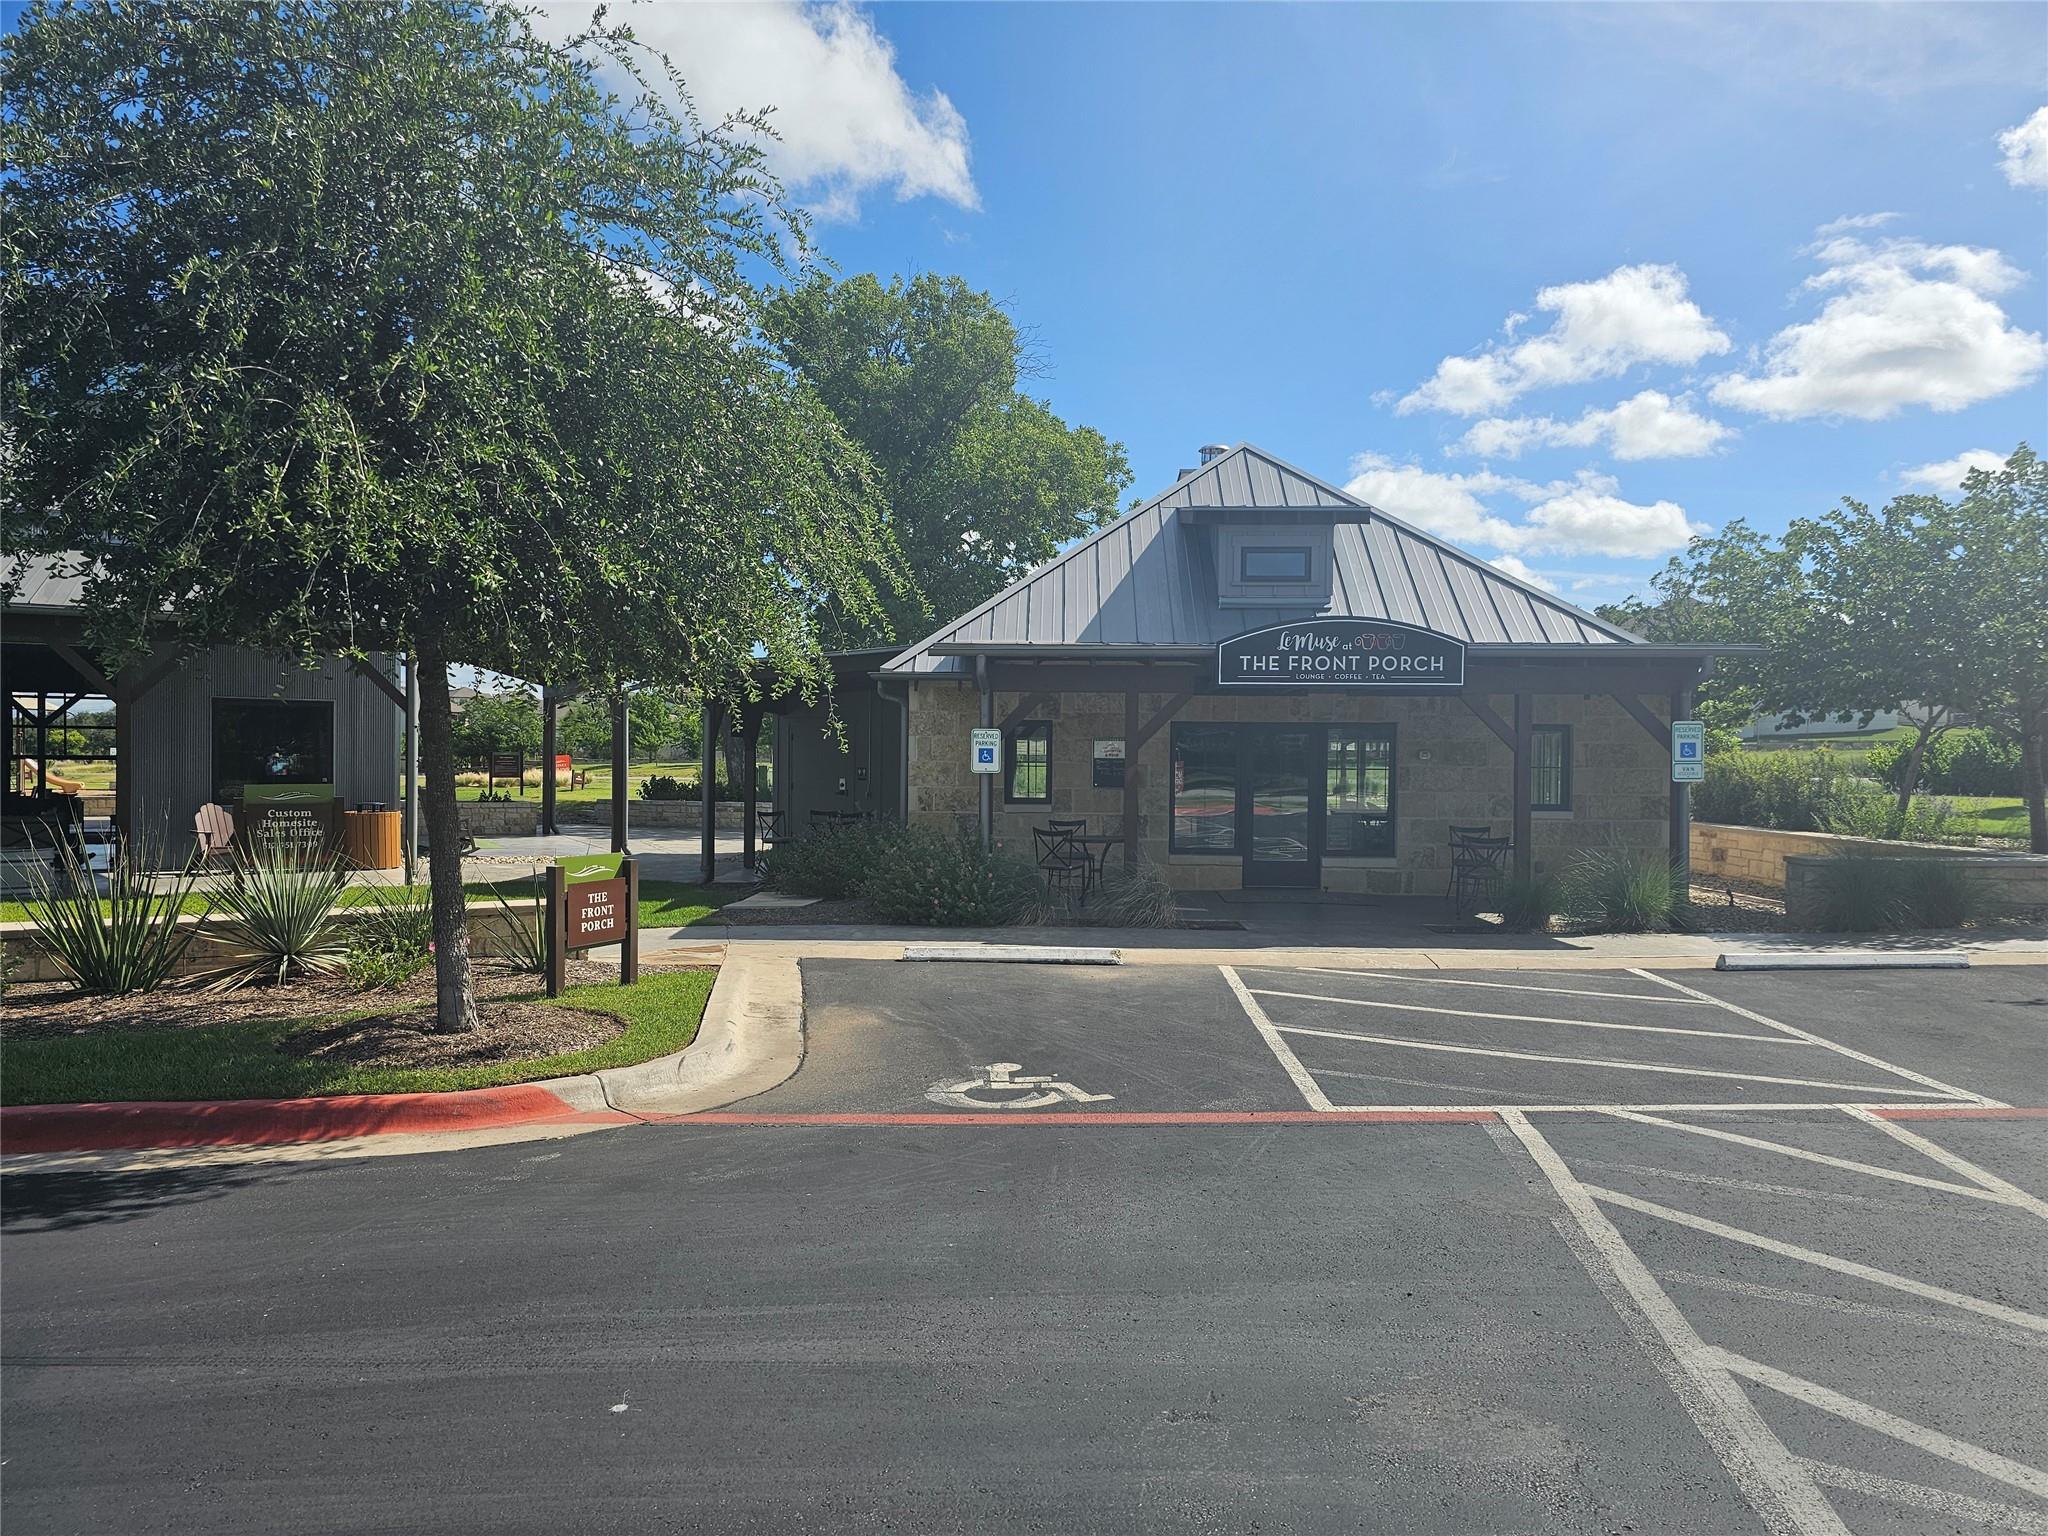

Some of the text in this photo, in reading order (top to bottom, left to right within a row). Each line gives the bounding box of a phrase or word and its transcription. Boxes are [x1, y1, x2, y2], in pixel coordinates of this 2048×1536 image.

[1277, 631, 1352, 652] LeMuse at
[1239, 655, 1444, 671] THE FRONT PORCH
[267, 809, 312, 817] Custom
[263, 818, 318, 828] Homesite
[256, 827, 323, 837] Sales Office
[587, 891, 608, 904] THE
[581, 904, 614, 919] FRONT
[581, 918, 614, 933] PORCH
